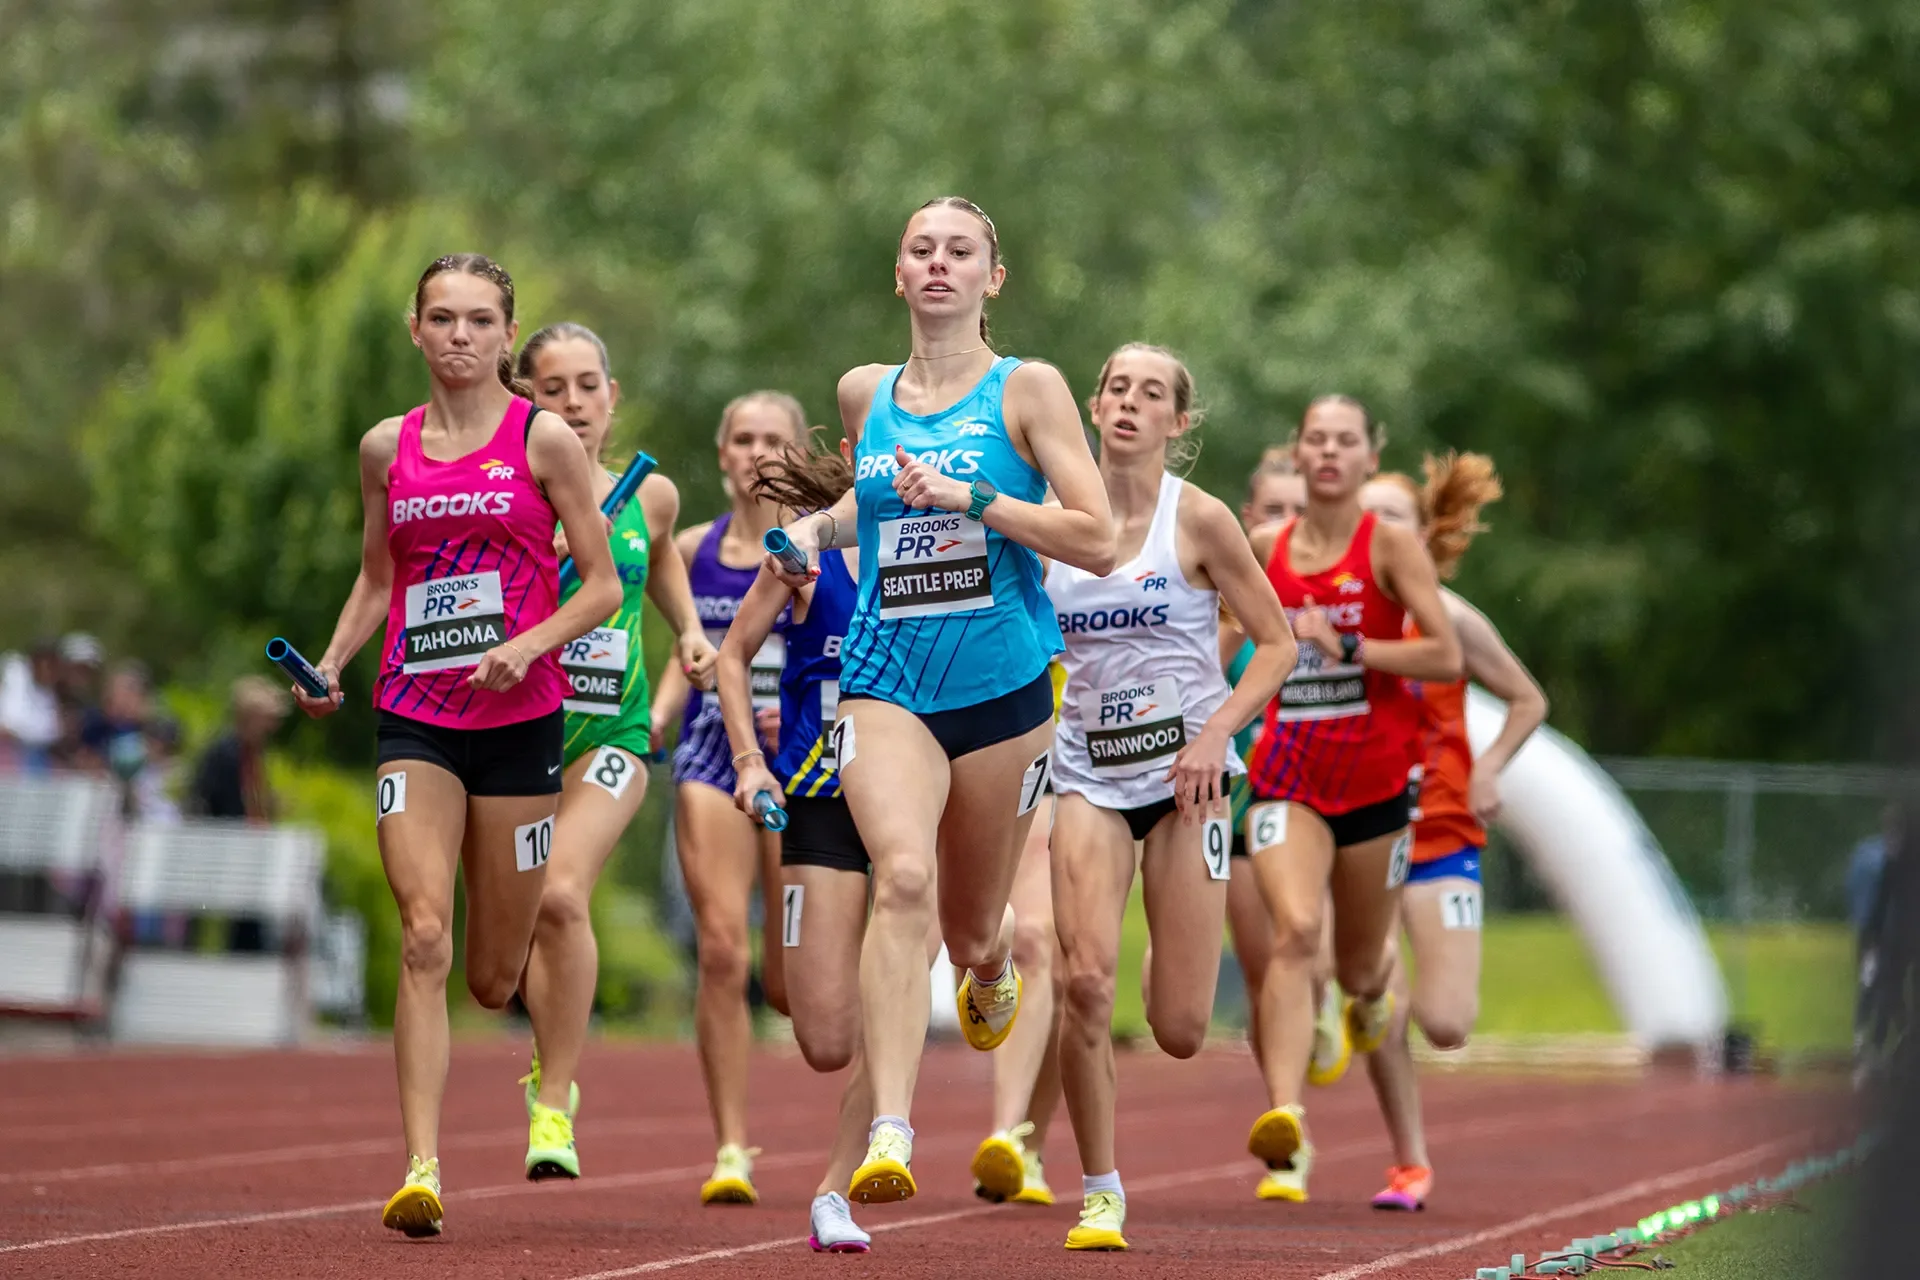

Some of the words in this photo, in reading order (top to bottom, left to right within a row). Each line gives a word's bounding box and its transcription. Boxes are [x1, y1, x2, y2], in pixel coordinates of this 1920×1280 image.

[958, 423, 987, 436] PR
[487, 466, 515, 480] PR
[392, 491, 514, 524] BROOKS
[900, 518, 960, 536] BROOKS
[893, 535, 938, 560] PR
[426, 578, 479, 596] BROOKS
[883, 571, 942, 597] SEATTLE
[943, 567, 984, 591] PREP
[1143, 576, 1168, 592] PR
[422, 595, 457, 619] PR
[1057, 604, 1170, 634] BROOKS
[411, 624, 500, 653] TAHOMA
[562, 642, 591, 662] PR
[1101, 684, 1155, 704] BROOKS
[1098, 702, 1134, 726] PR
[1090, 726, 1180, 759] STANWOOD
[595, 752, 626, 788] 8
[1026, 754, 1049, 810] 7
[1256, 807, 1277, 847] 6
[525, 821, 551, 866] 10
[1208, 821, 1223, 875] 9
[786, 890, 796, 943] 1
[1450, 895, 1475, 927] 11
